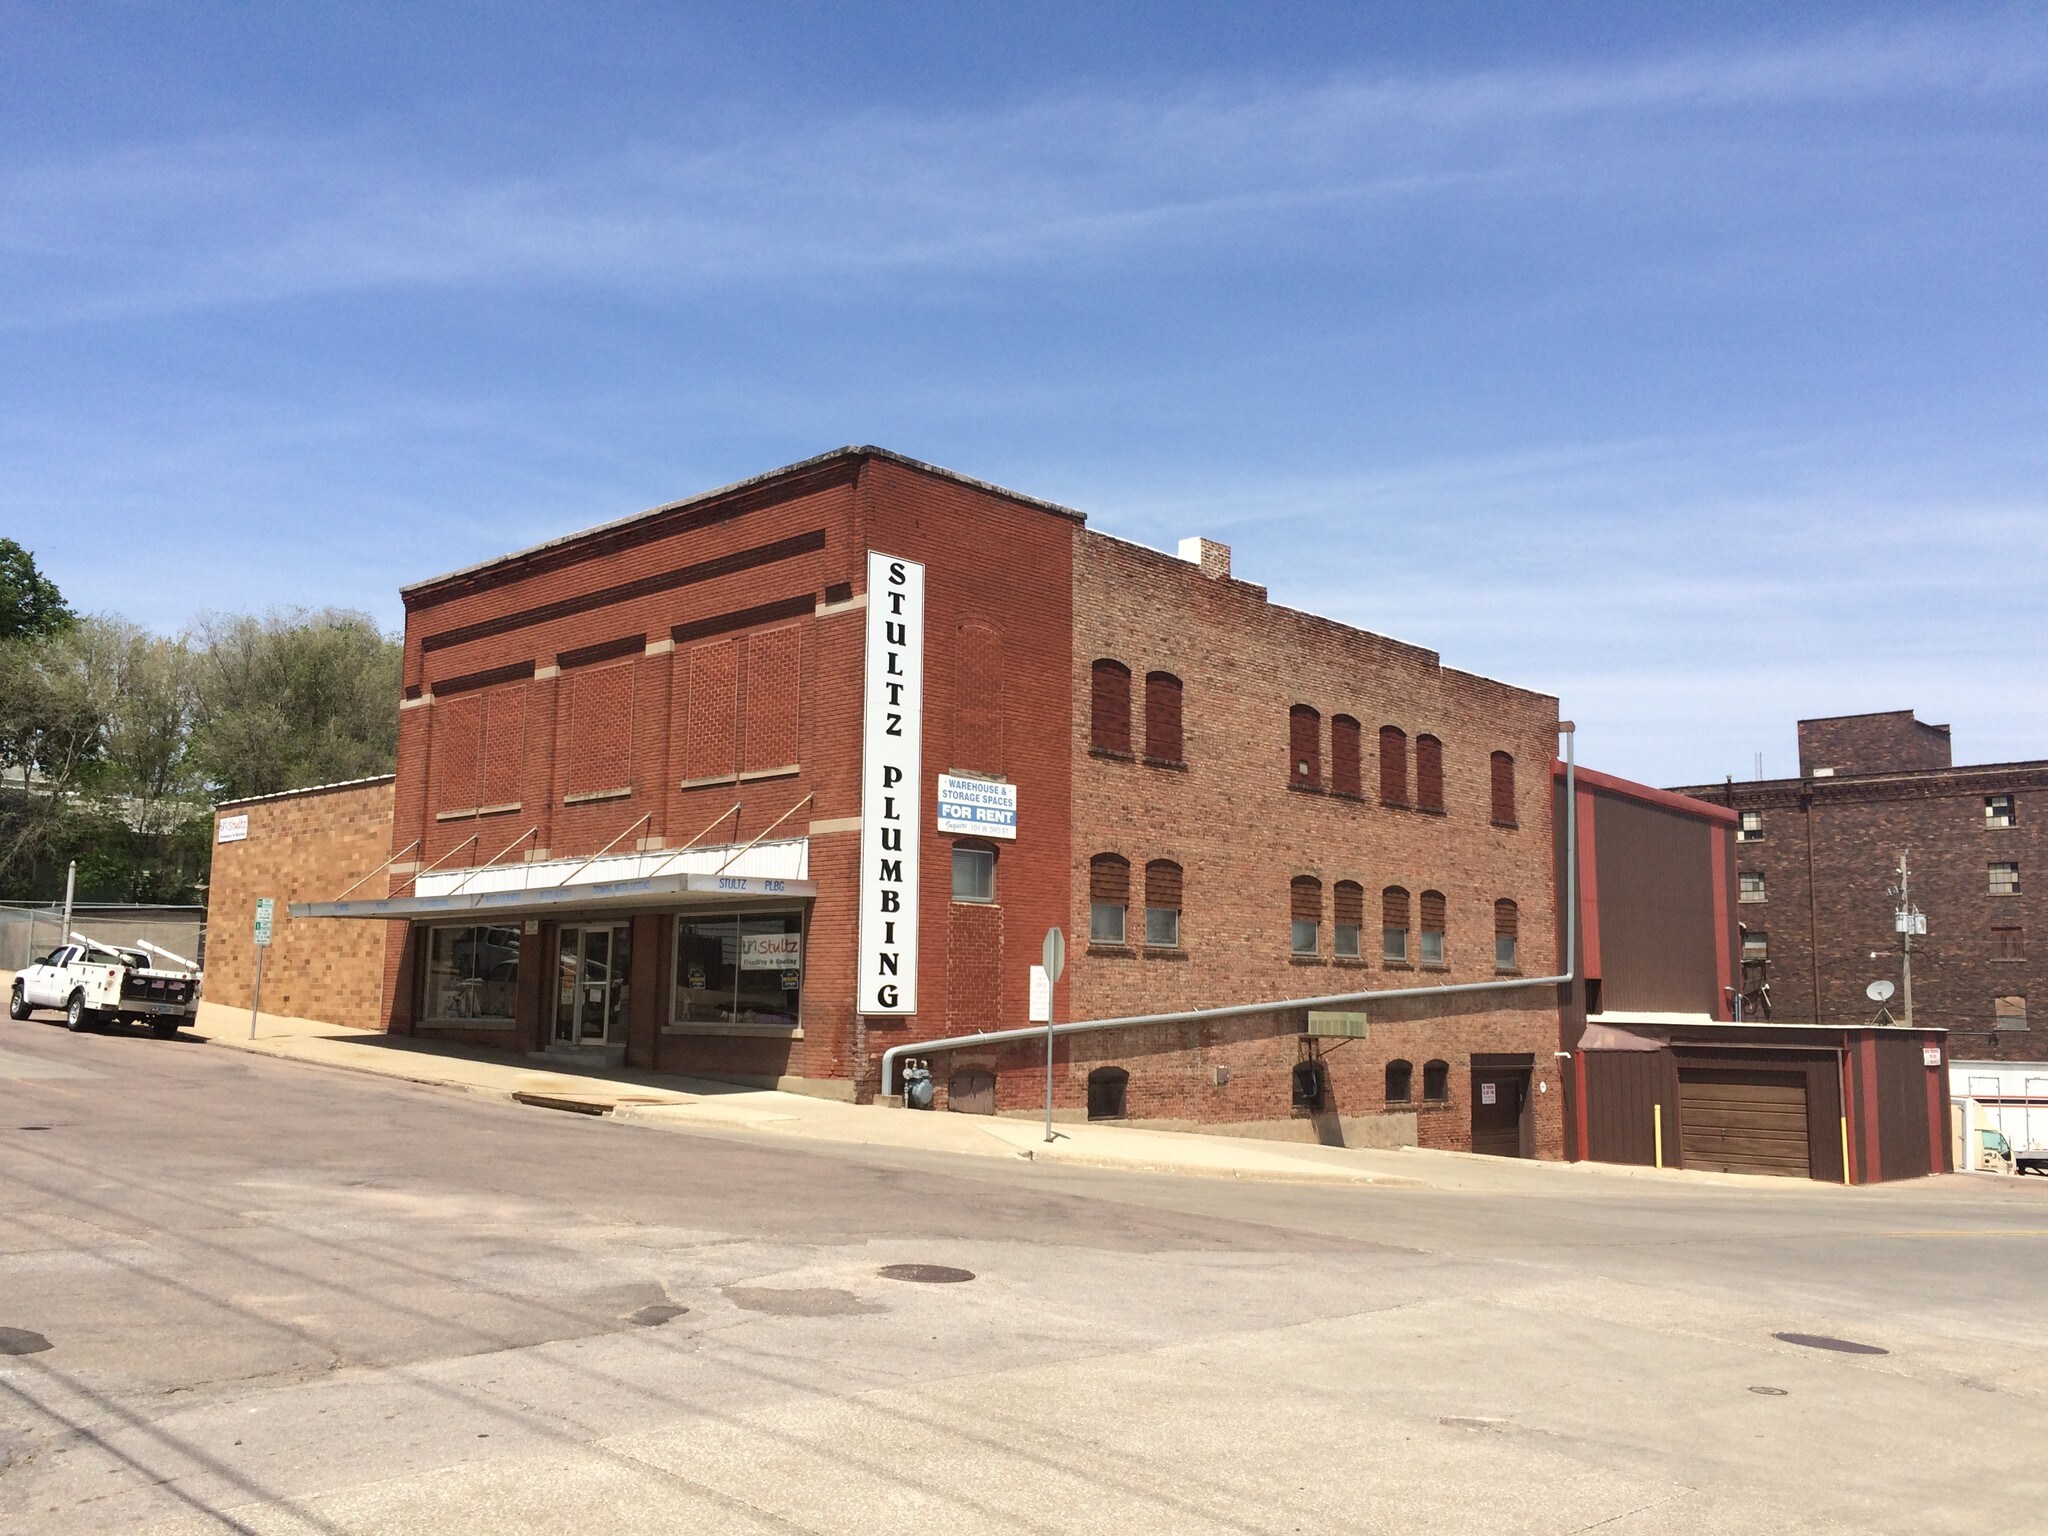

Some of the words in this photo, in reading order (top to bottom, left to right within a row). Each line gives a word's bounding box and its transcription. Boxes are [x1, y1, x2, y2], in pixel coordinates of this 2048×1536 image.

[885, 562, 907, 738] STULTZ
[948, 779, 999, 794] WAREHOUSE
[1001, 787, 1007, 796] &
[942, 789, 981, 802] STORAGE
[982, 795, 1013, 807] SPACES
[942, 804, 972, 819] FOR
[976, 808, 1014, 824] RENT
[719, 878, 747, 890] STULTZ
[764, 880, 785, 892] PLBG
[877, 765, 903, 1008] PLUMBING
[758, 938, 798, 954] Stultz
